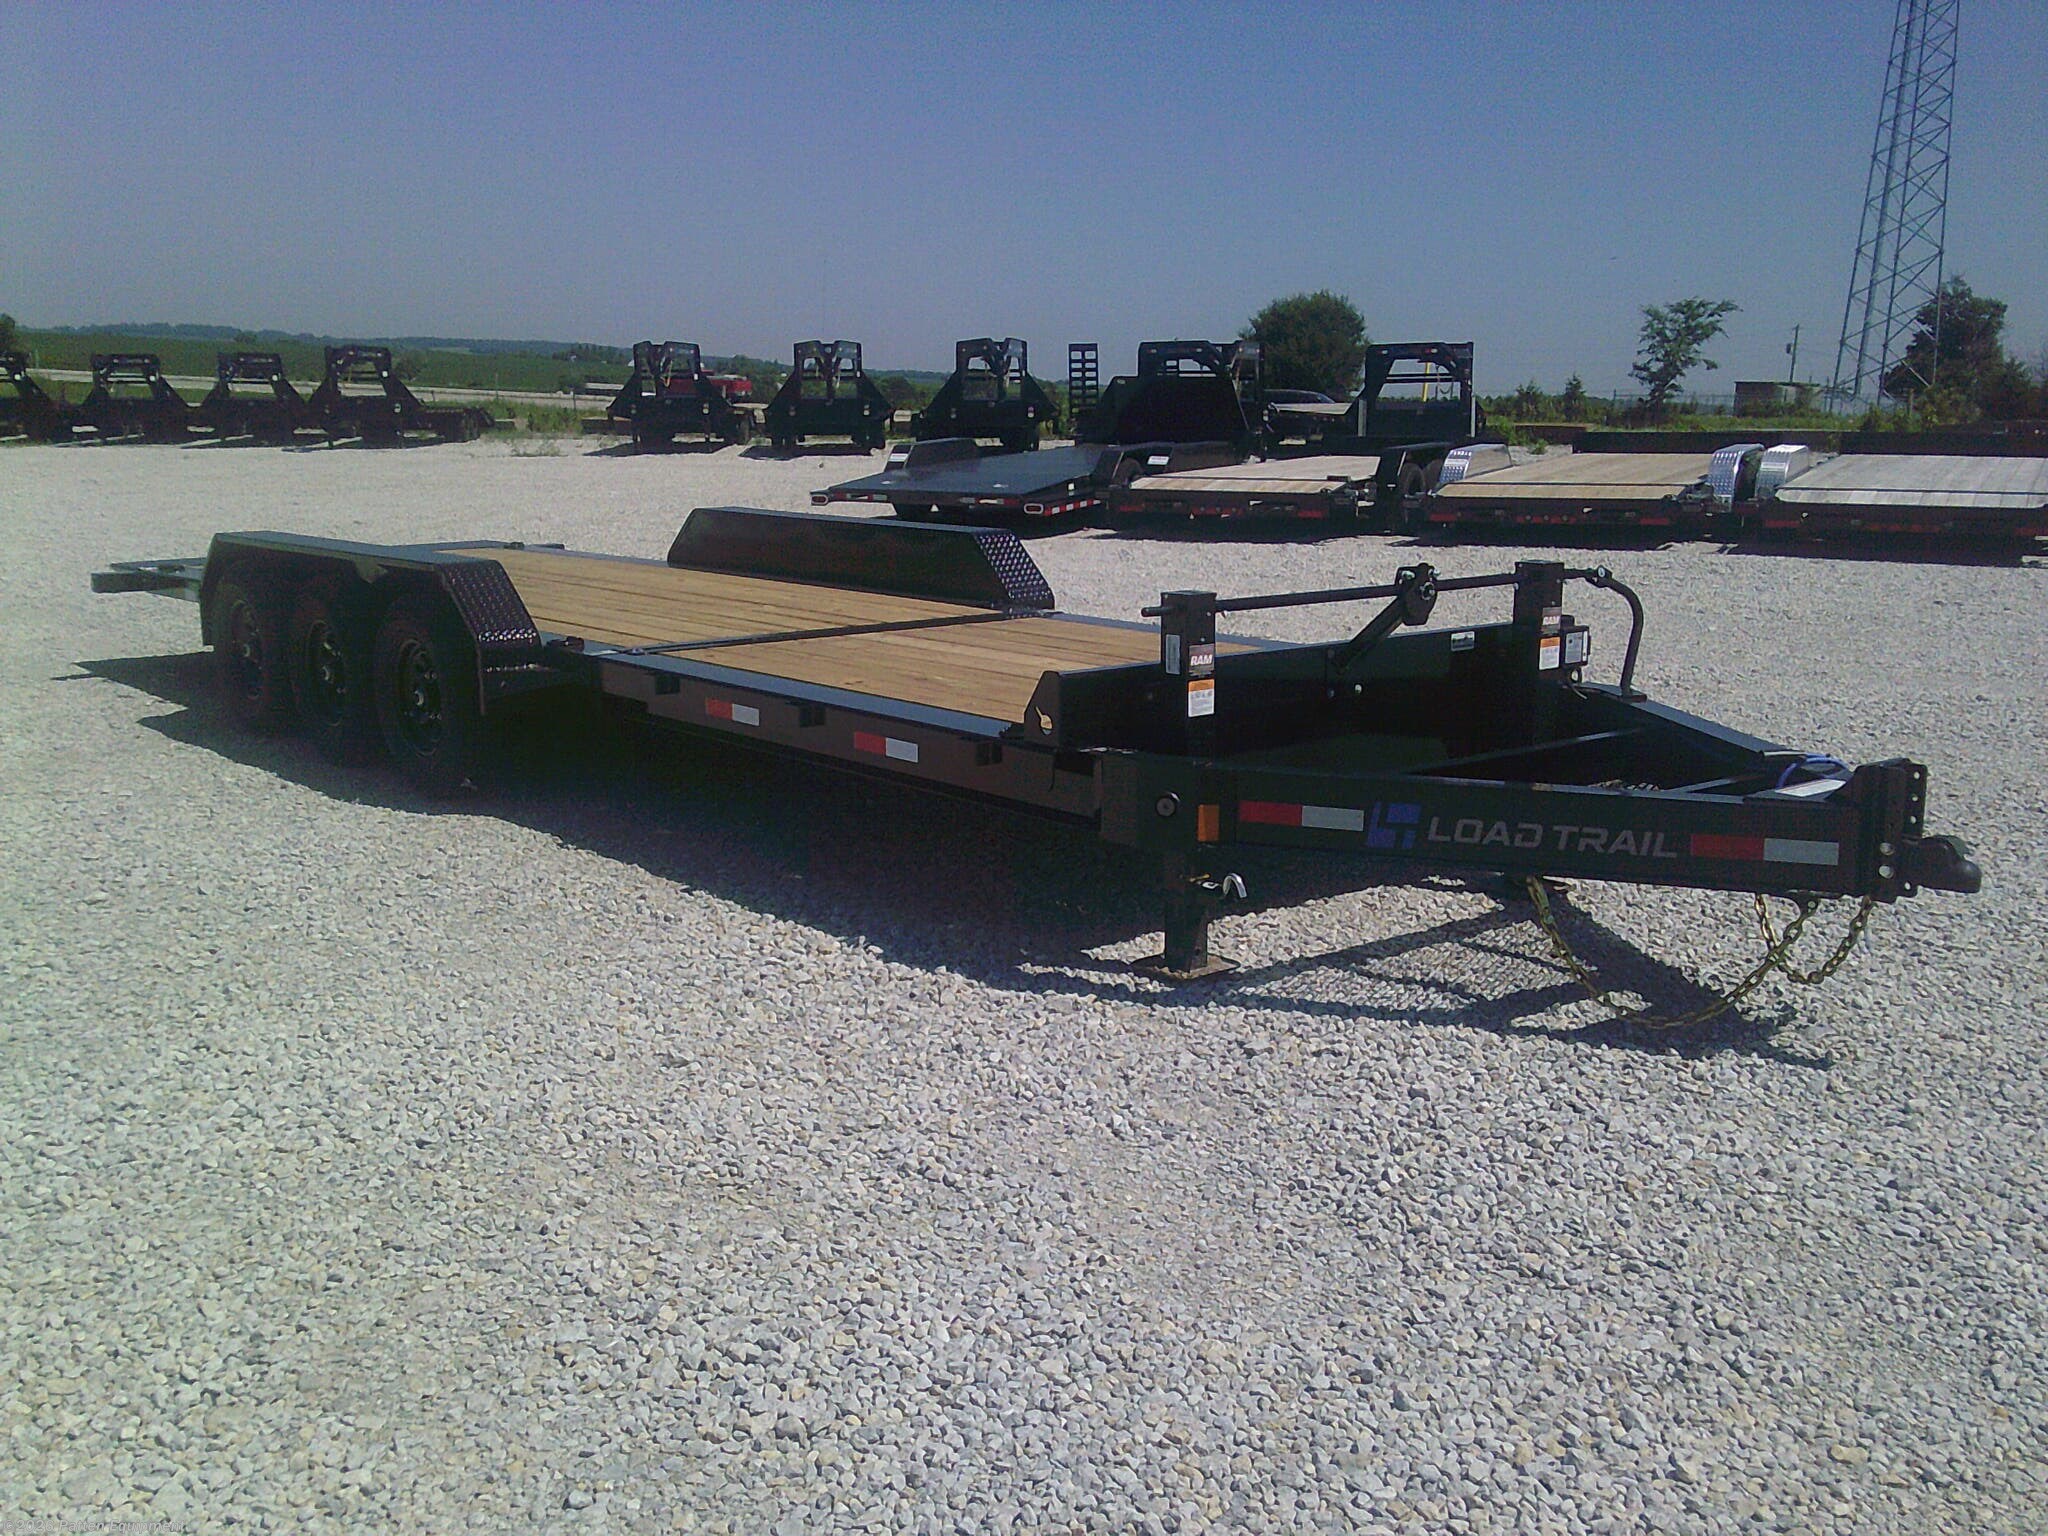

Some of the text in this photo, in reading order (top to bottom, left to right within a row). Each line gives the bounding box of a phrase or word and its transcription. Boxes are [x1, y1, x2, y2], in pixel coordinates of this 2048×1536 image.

[1190, 653, 1213, 666] RAM
[1427, 816, 1543, 849] LOAD
[1553, 825, 1677, 859] TRAIL
